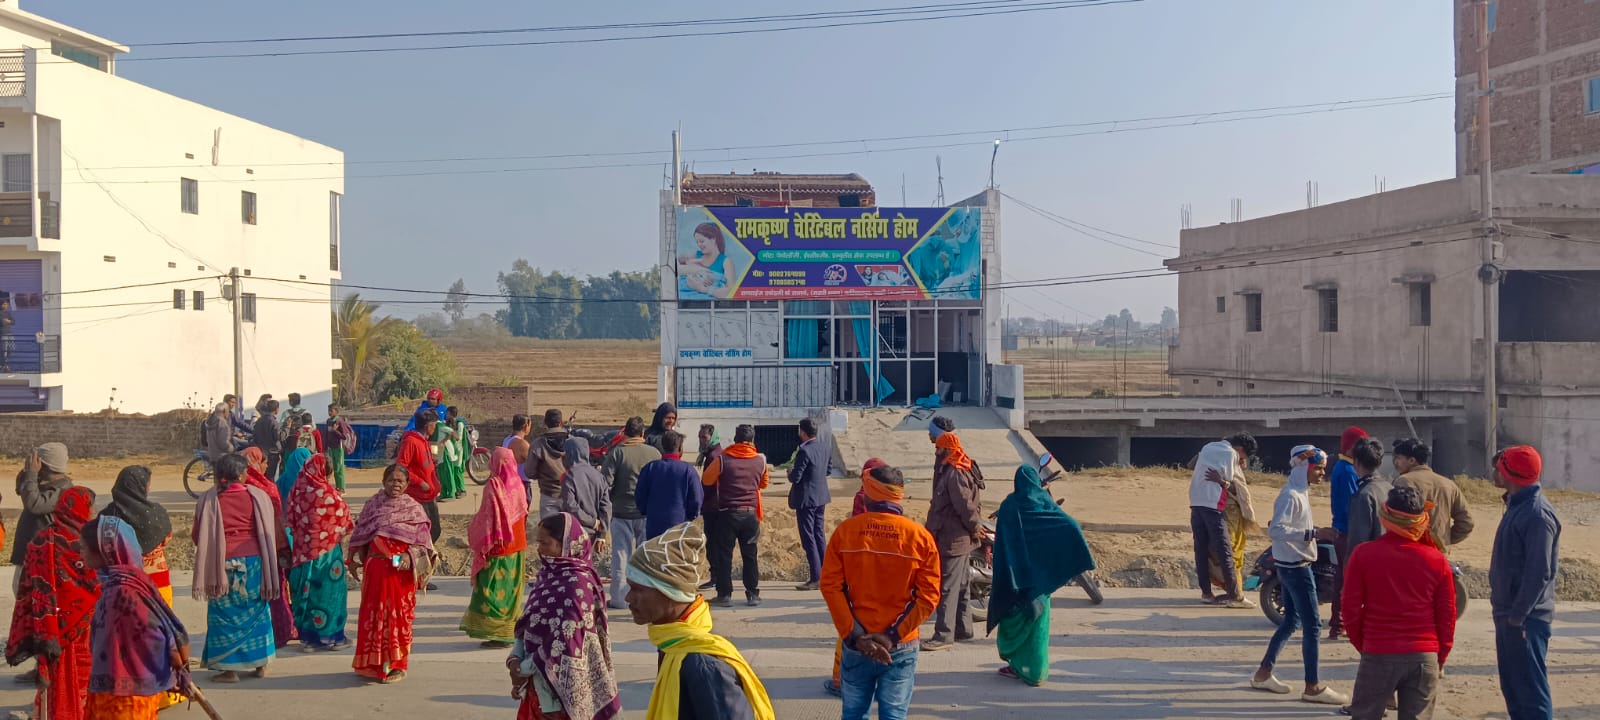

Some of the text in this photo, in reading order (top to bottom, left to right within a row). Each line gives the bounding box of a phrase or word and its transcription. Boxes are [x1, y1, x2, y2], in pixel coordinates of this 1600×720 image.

[734, 212, 919, 245] रामकृष्ण चेरिटेबल नर्सिंग होम
